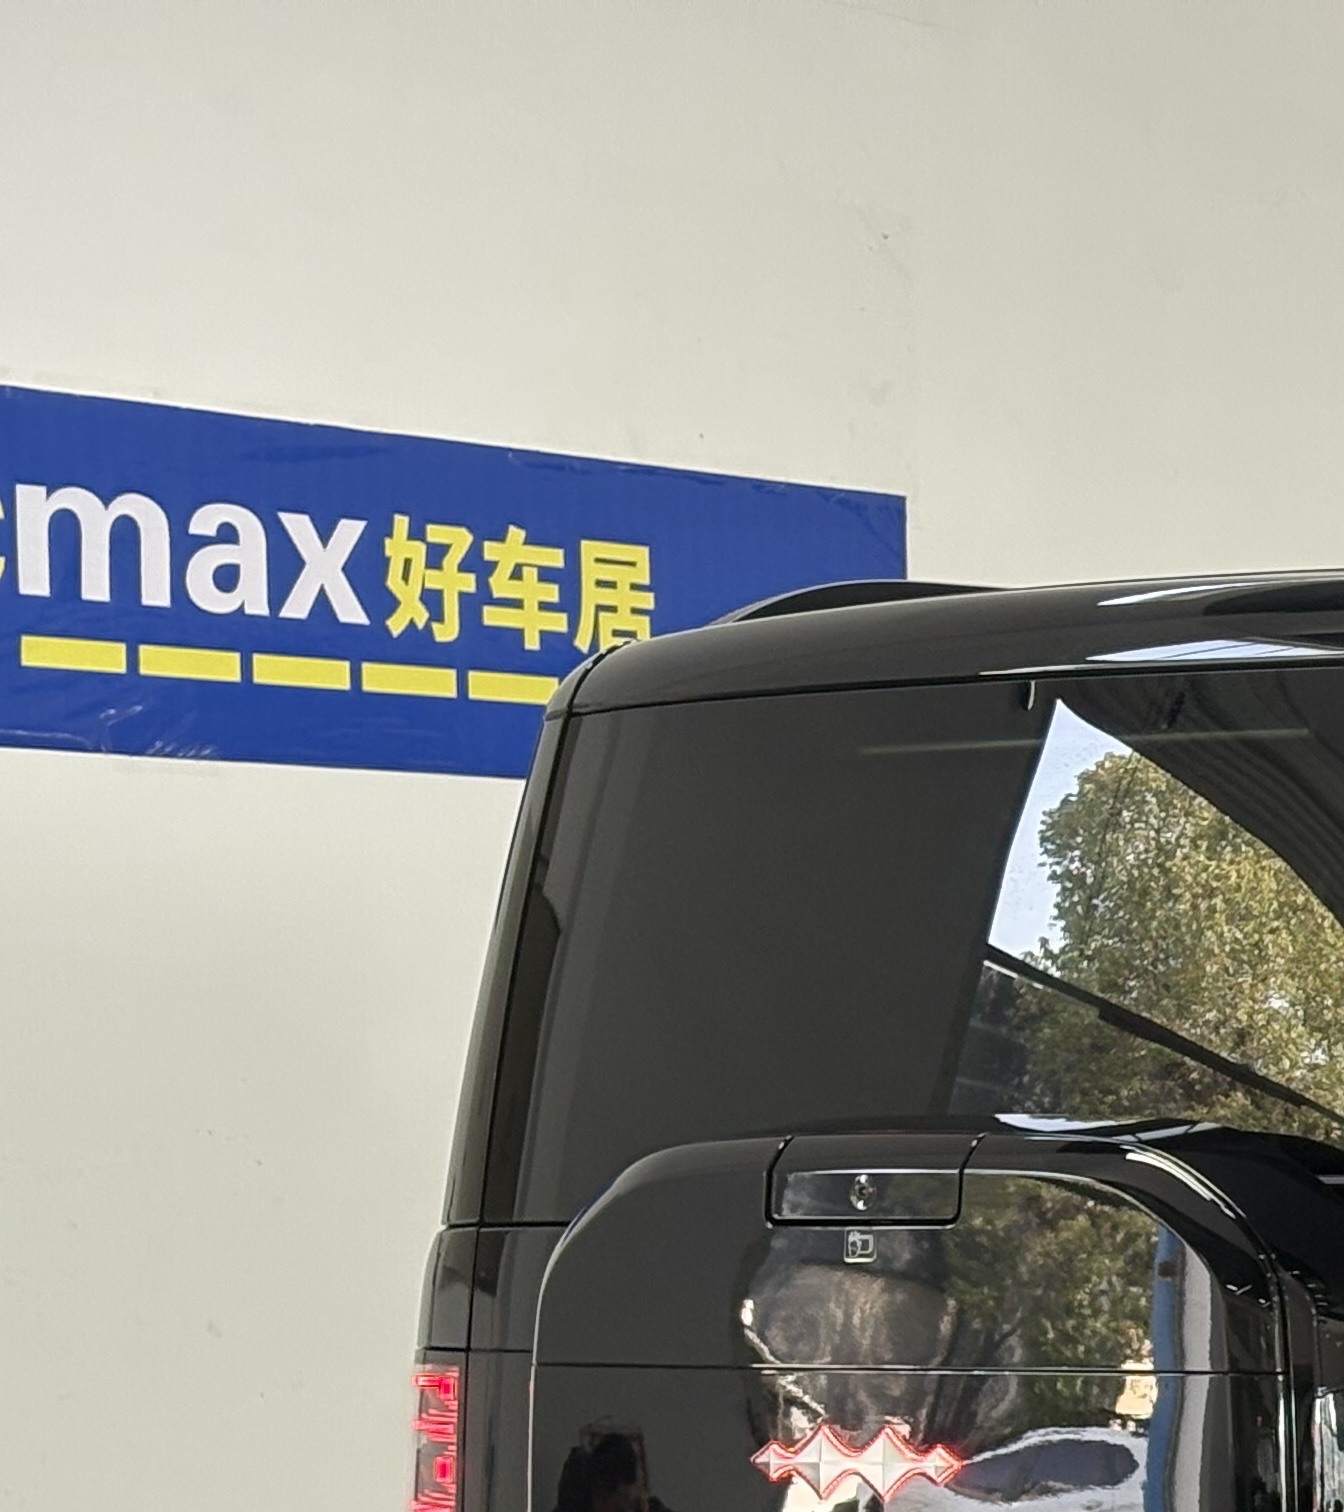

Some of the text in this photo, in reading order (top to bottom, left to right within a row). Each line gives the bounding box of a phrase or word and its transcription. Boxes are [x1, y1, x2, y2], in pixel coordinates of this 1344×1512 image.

[0, 483, 655, 652] max 好车居
